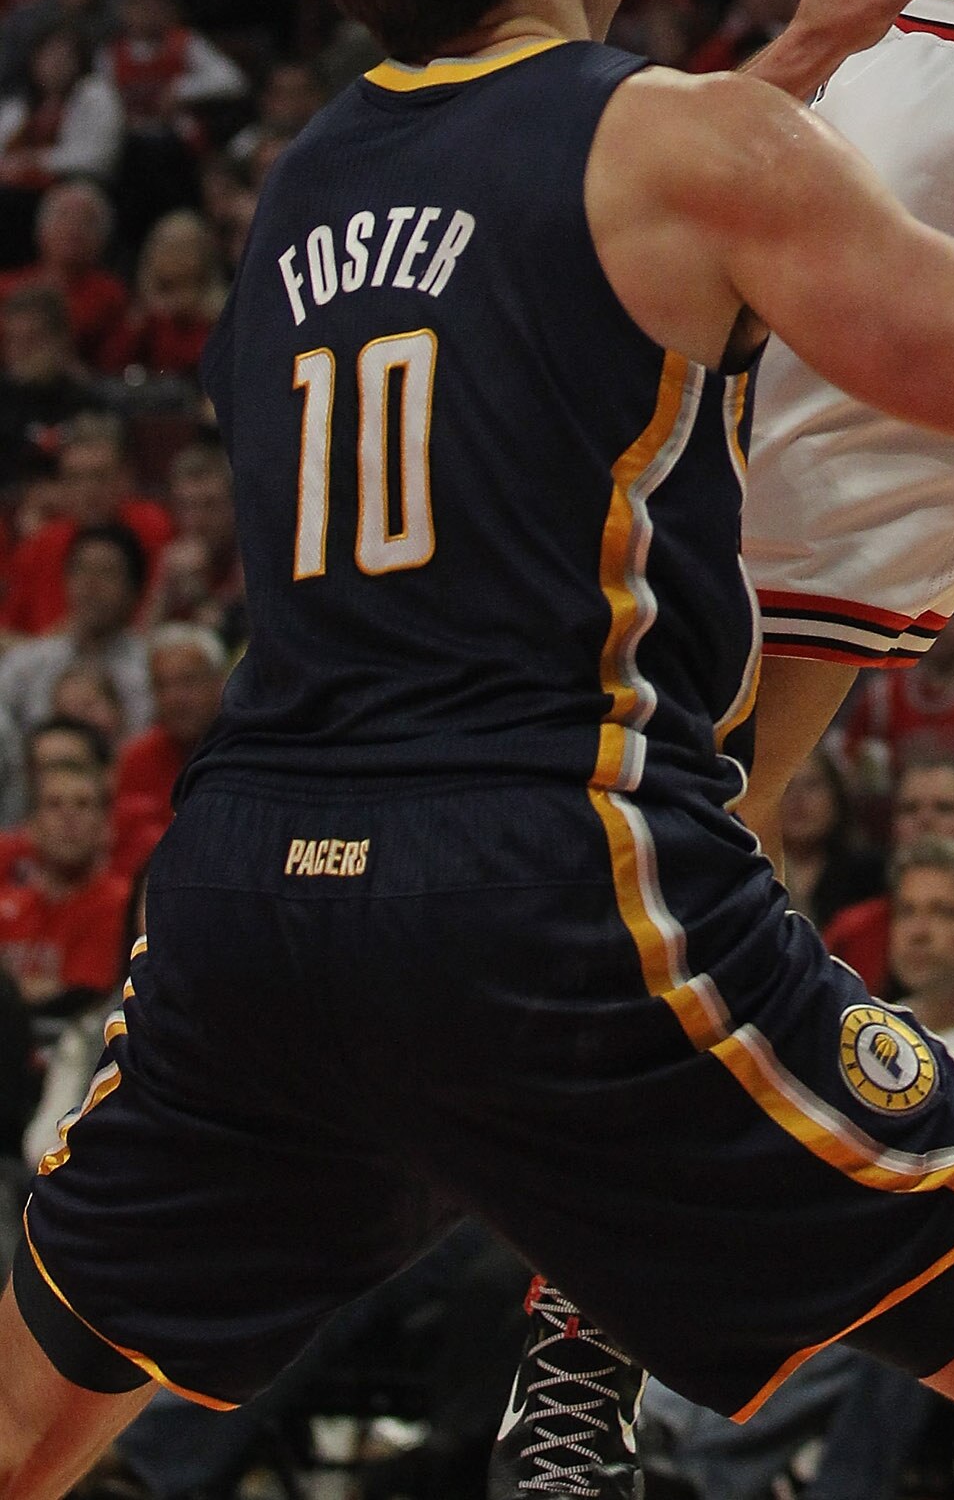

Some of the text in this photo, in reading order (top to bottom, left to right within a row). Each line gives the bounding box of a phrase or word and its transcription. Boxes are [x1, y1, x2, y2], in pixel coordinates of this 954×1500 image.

[277, 205, 477, 326] FOSTER
[291, 326, 439, 583] 10
[283, 837, 371, 877] PACERS
